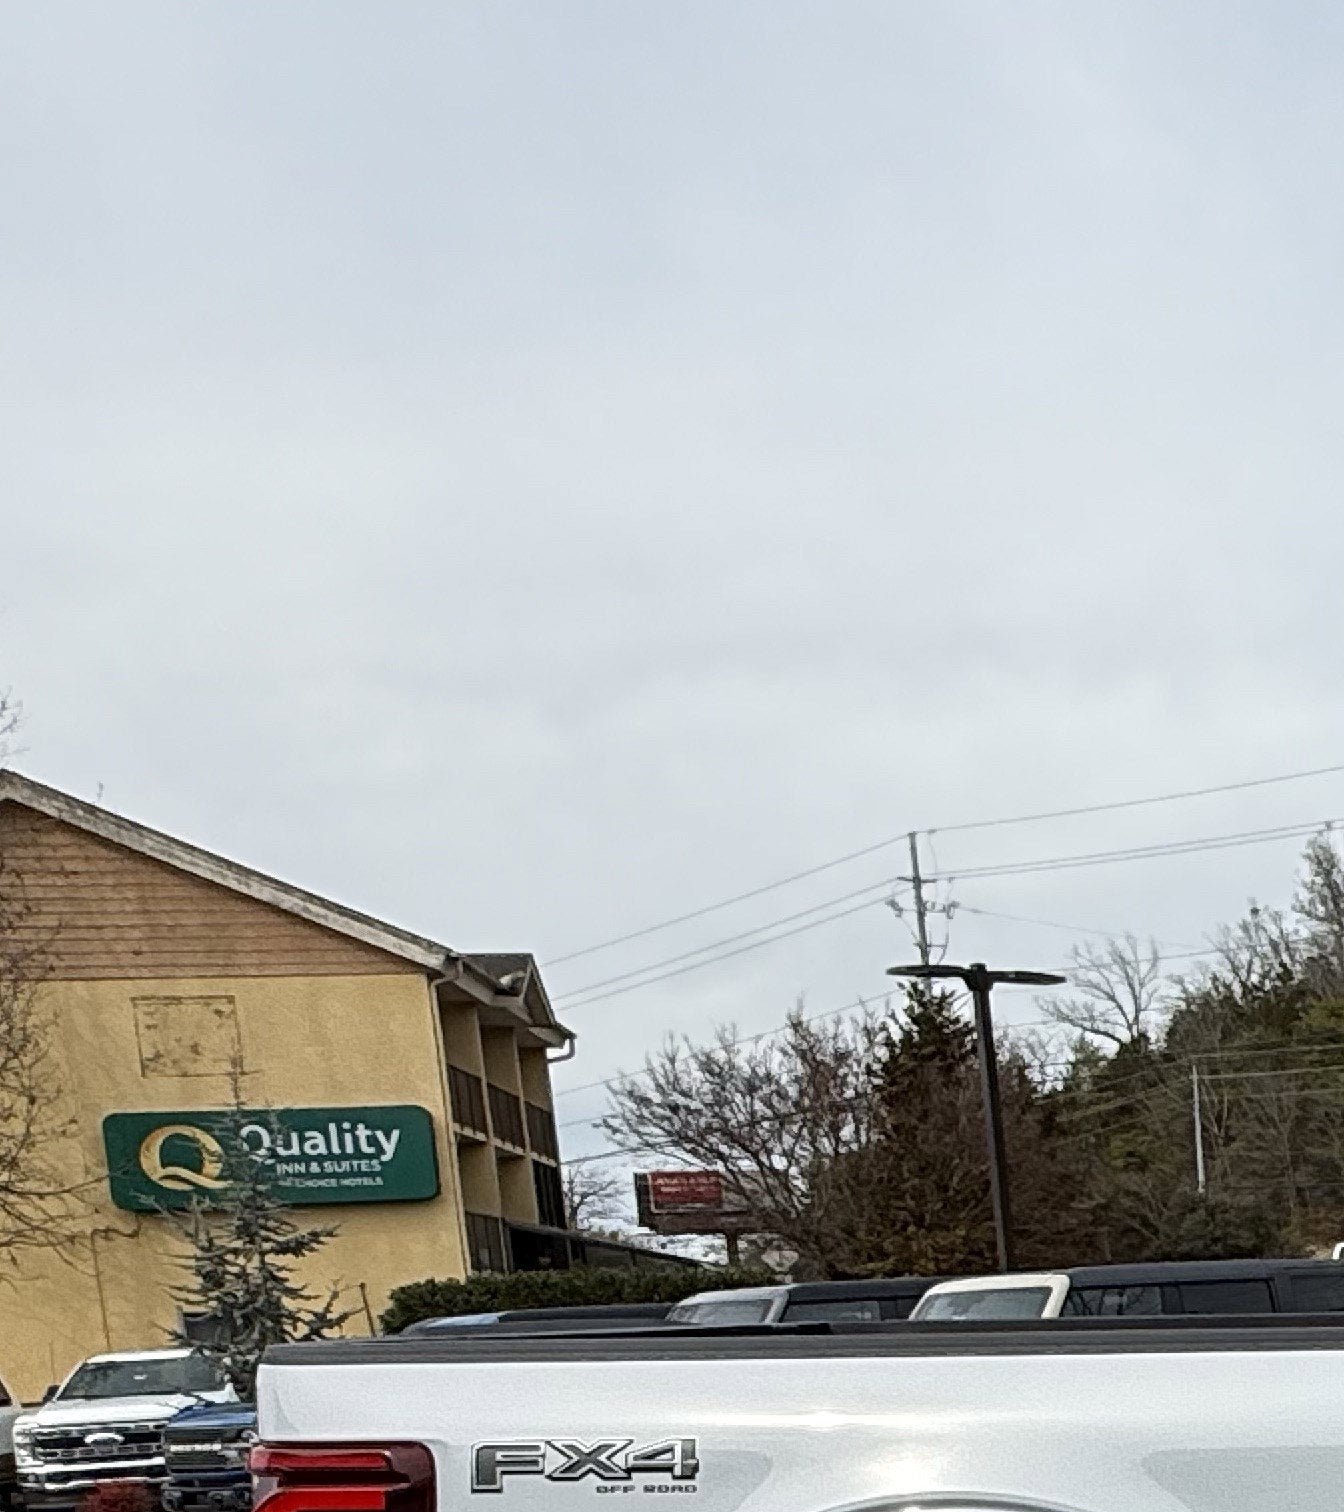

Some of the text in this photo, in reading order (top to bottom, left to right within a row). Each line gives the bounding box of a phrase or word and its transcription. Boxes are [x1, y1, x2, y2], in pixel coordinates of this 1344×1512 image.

[240, 1122, 400, 1164] Quality
[276, 1159, 382, 1175] INN & SUITES
[470, 1437, 700, 1495] FX4
[596, 1484, 698, 1494] OFF ROAD
